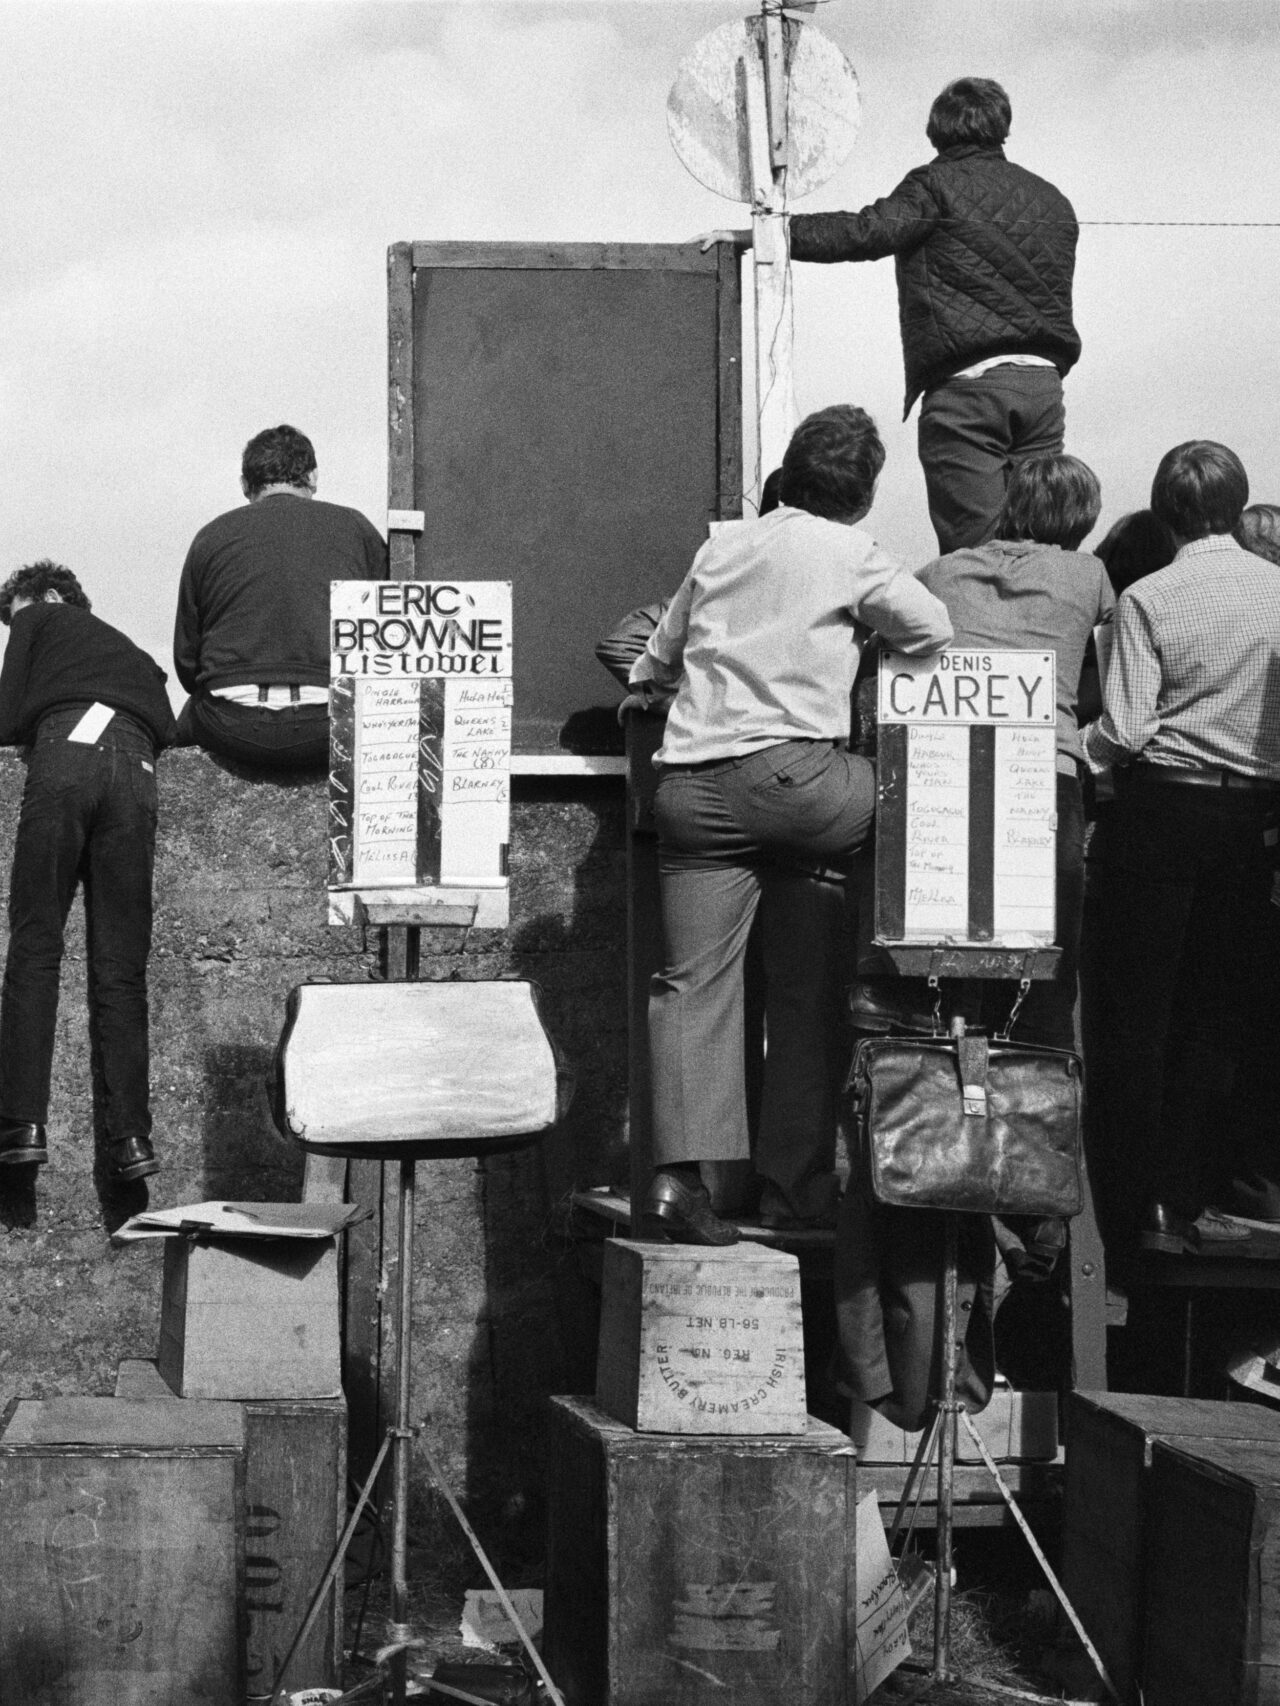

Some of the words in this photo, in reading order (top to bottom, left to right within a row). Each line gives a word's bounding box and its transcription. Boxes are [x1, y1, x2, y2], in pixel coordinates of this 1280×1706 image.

[376, 584, 462, 617] ERIC
[332, 618, 503, 652] BROWNE
[940, 655, 992, 672] DENIS
[890, 674, 1043, 718] CAREY
[685, 1316, 713, 1328] NET
[656, 1344, 689, 1400] BUTTER
[766, 1348, 787, 1388] IRISH
[689, 1388, 767, 1414] CREAMERY
